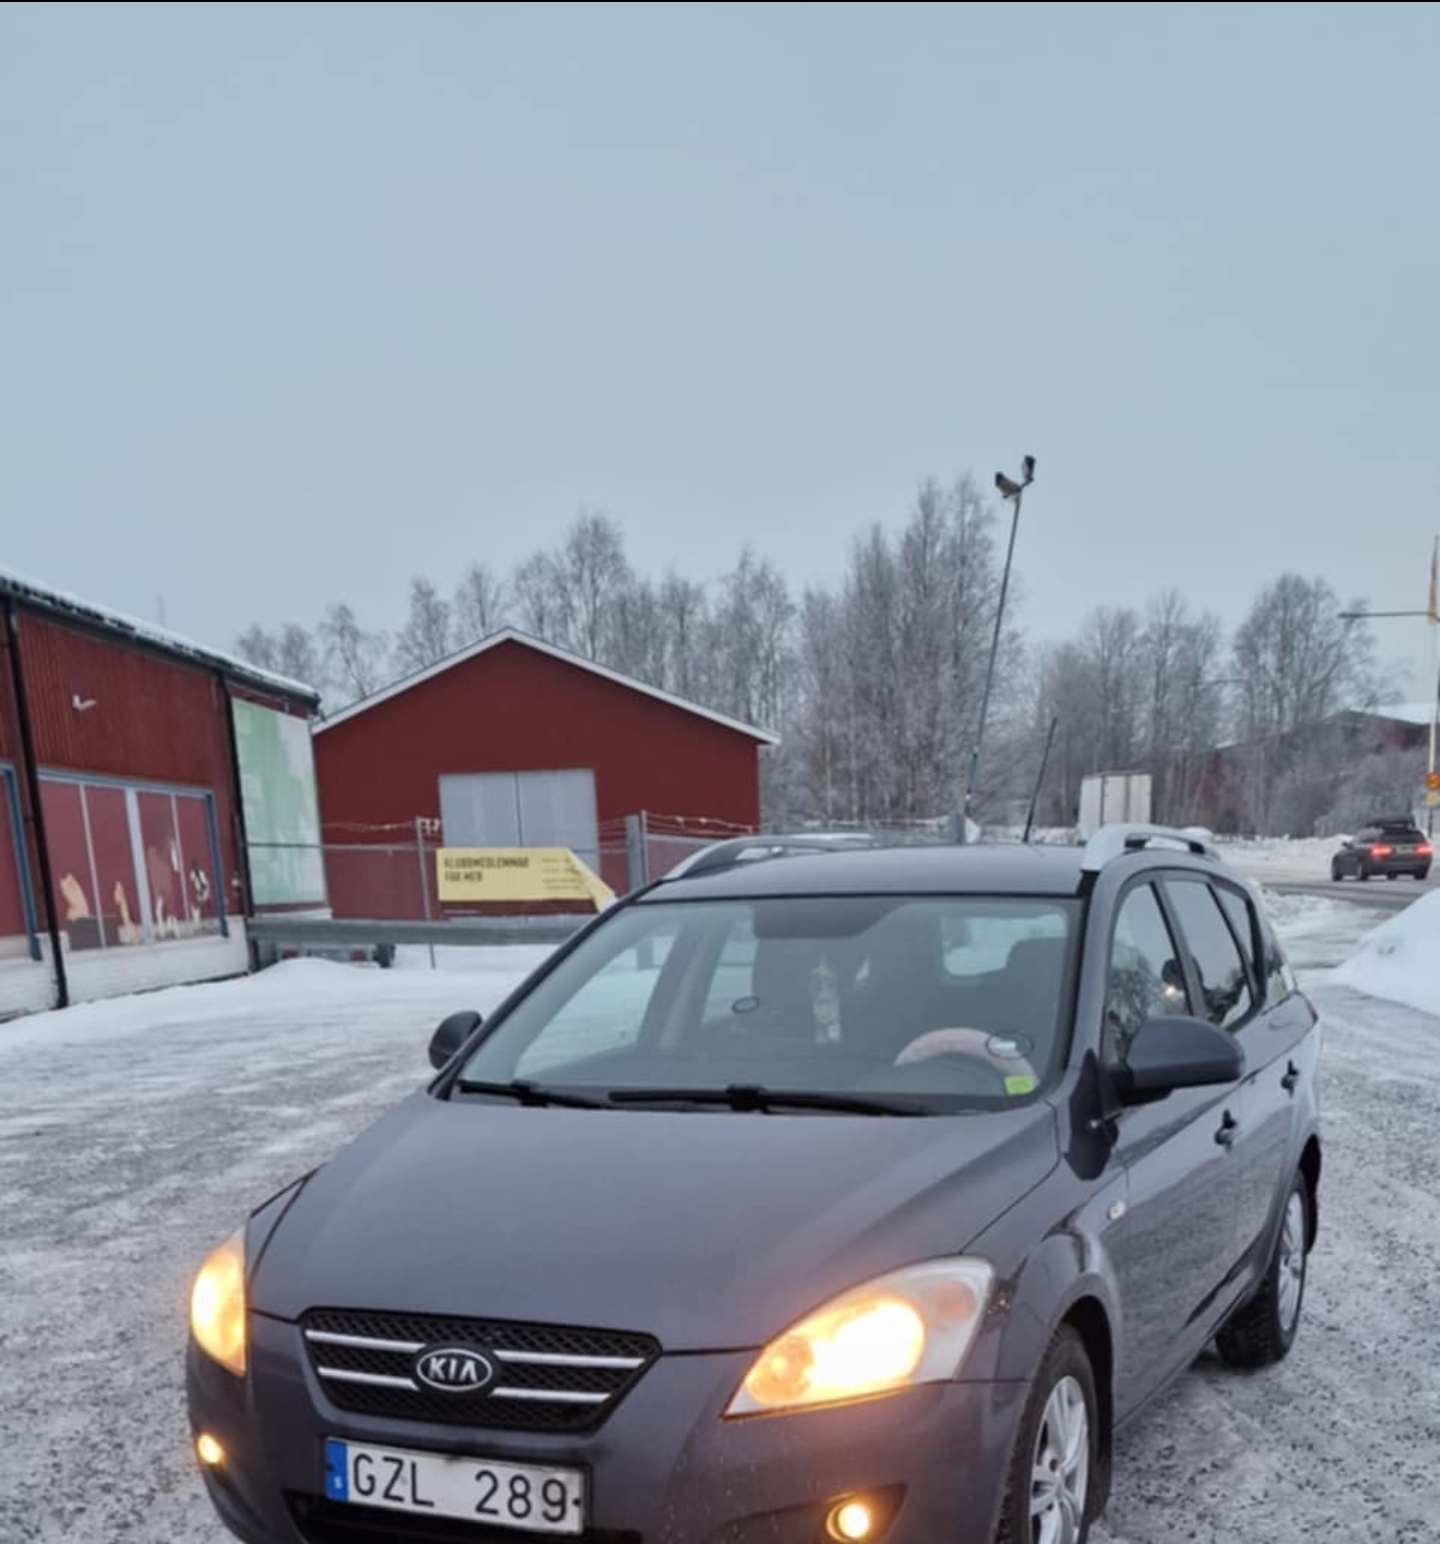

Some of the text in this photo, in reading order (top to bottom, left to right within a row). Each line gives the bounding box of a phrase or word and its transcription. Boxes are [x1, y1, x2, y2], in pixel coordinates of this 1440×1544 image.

[428, 1357, 478, 1382] KIA
[353, 1453, 568, 1522] GZL 289
